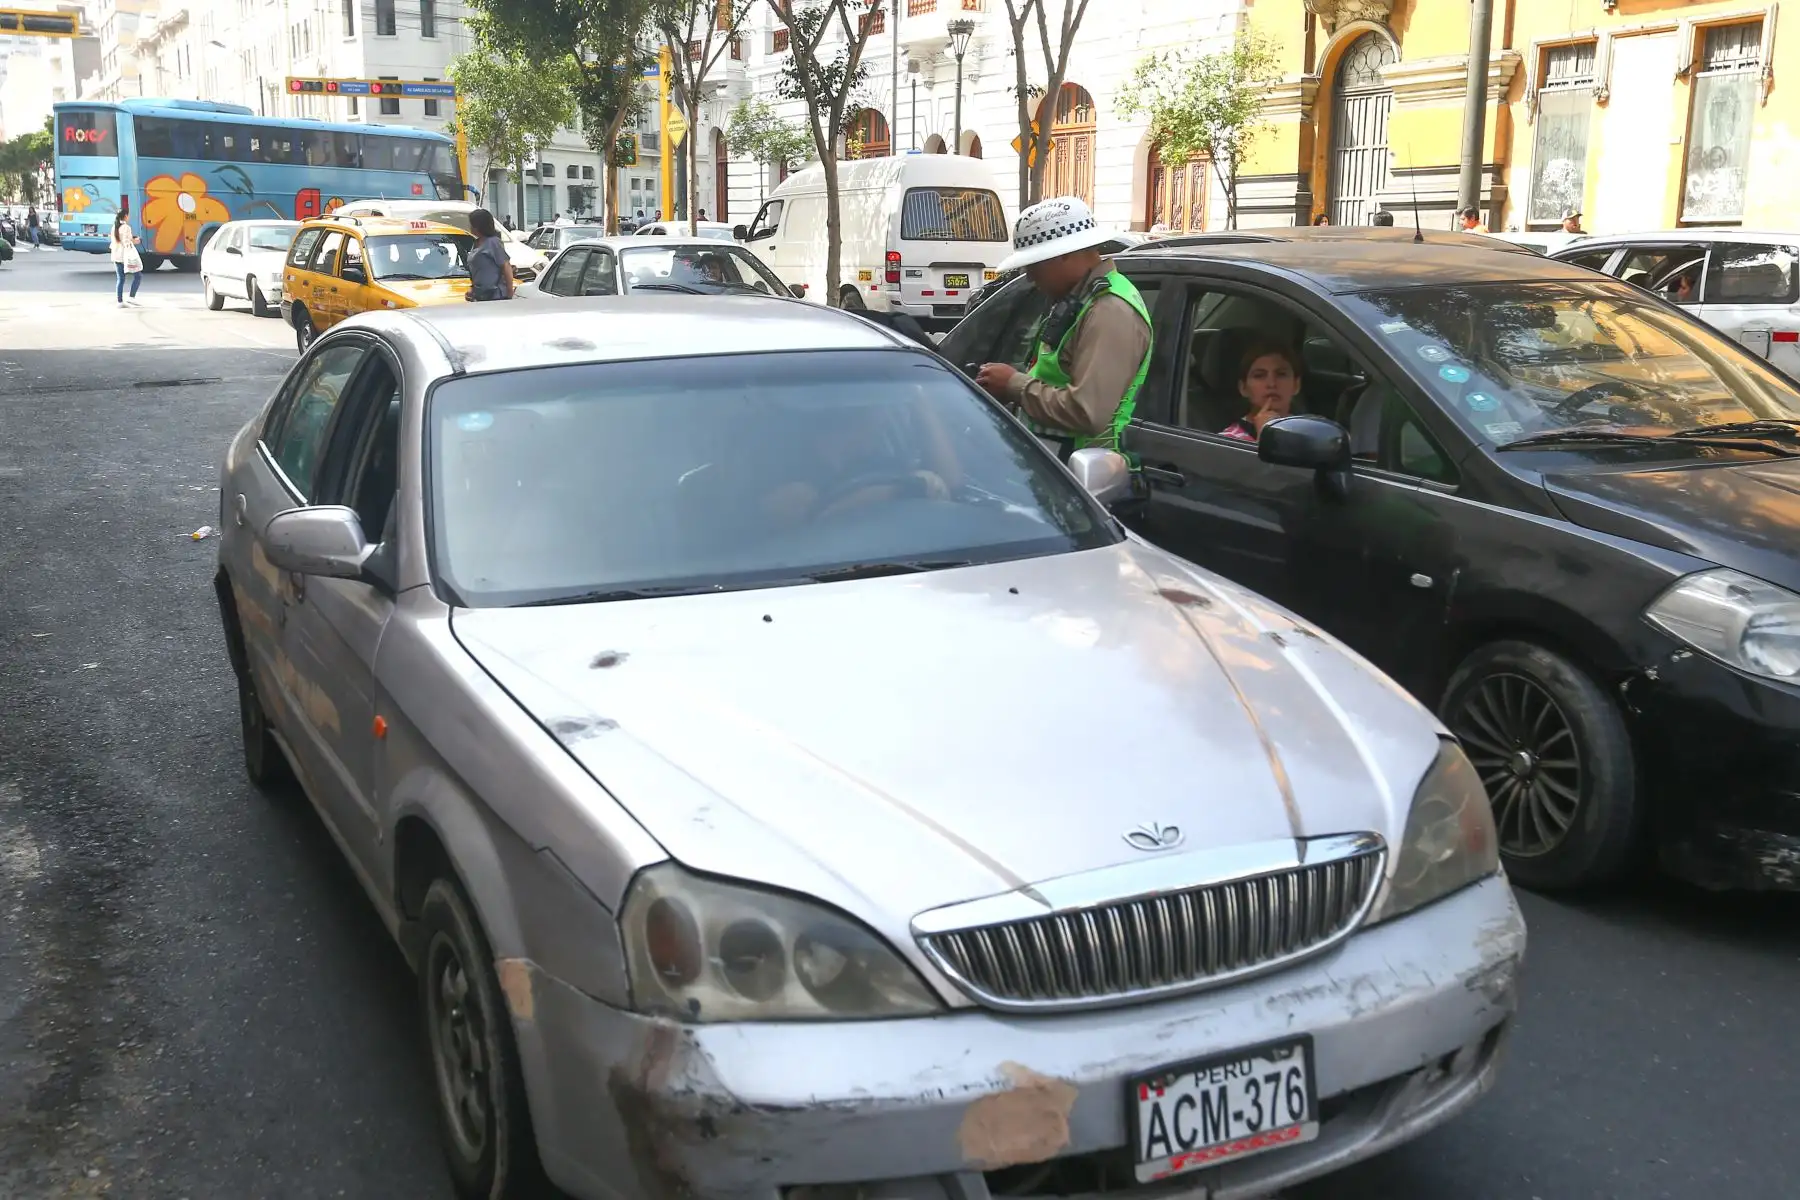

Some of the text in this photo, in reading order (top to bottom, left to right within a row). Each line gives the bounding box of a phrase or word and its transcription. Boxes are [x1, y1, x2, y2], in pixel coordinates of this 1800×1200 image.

[410, 221, 427, 229] TAXI
[1194, 1060, 1253, 1088] PERU
[1146, 1066, 1305, 1160] ACM-376
